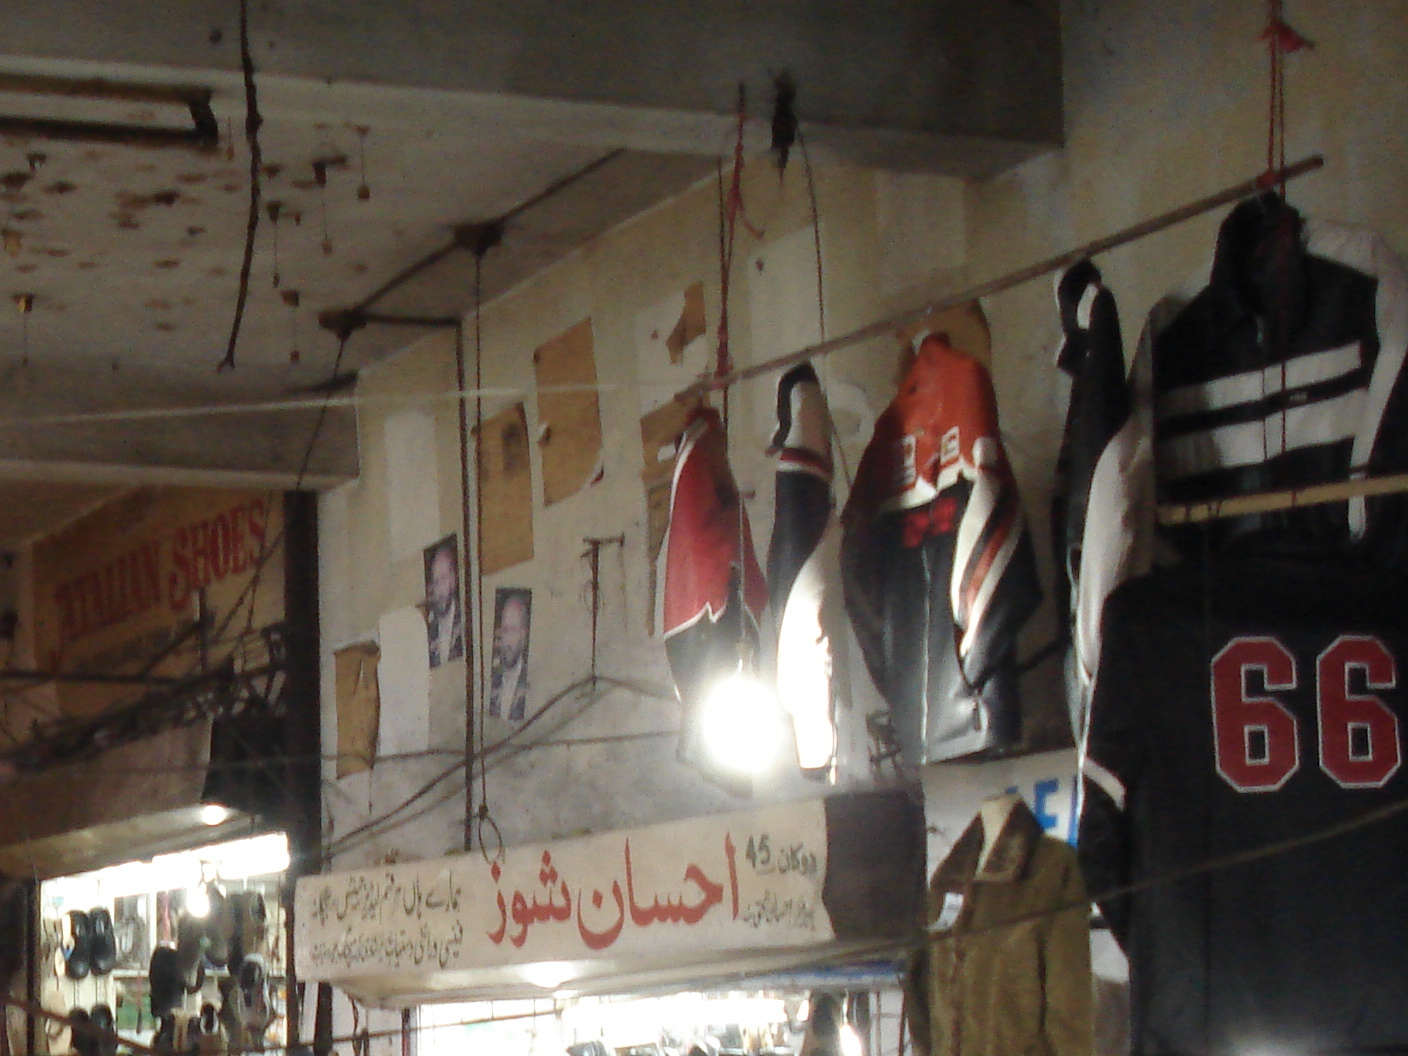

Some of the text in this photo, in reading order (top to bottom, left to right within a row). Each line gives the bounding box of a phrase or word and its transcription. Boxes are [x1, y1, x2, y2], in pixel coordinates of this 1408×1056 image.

[169, 496, 265, 612] SHOES
[1210, 634, 1402, 794] 66
[486, 831, 738, 950] احسان شوز
[745, 833, 771, 868] 45
